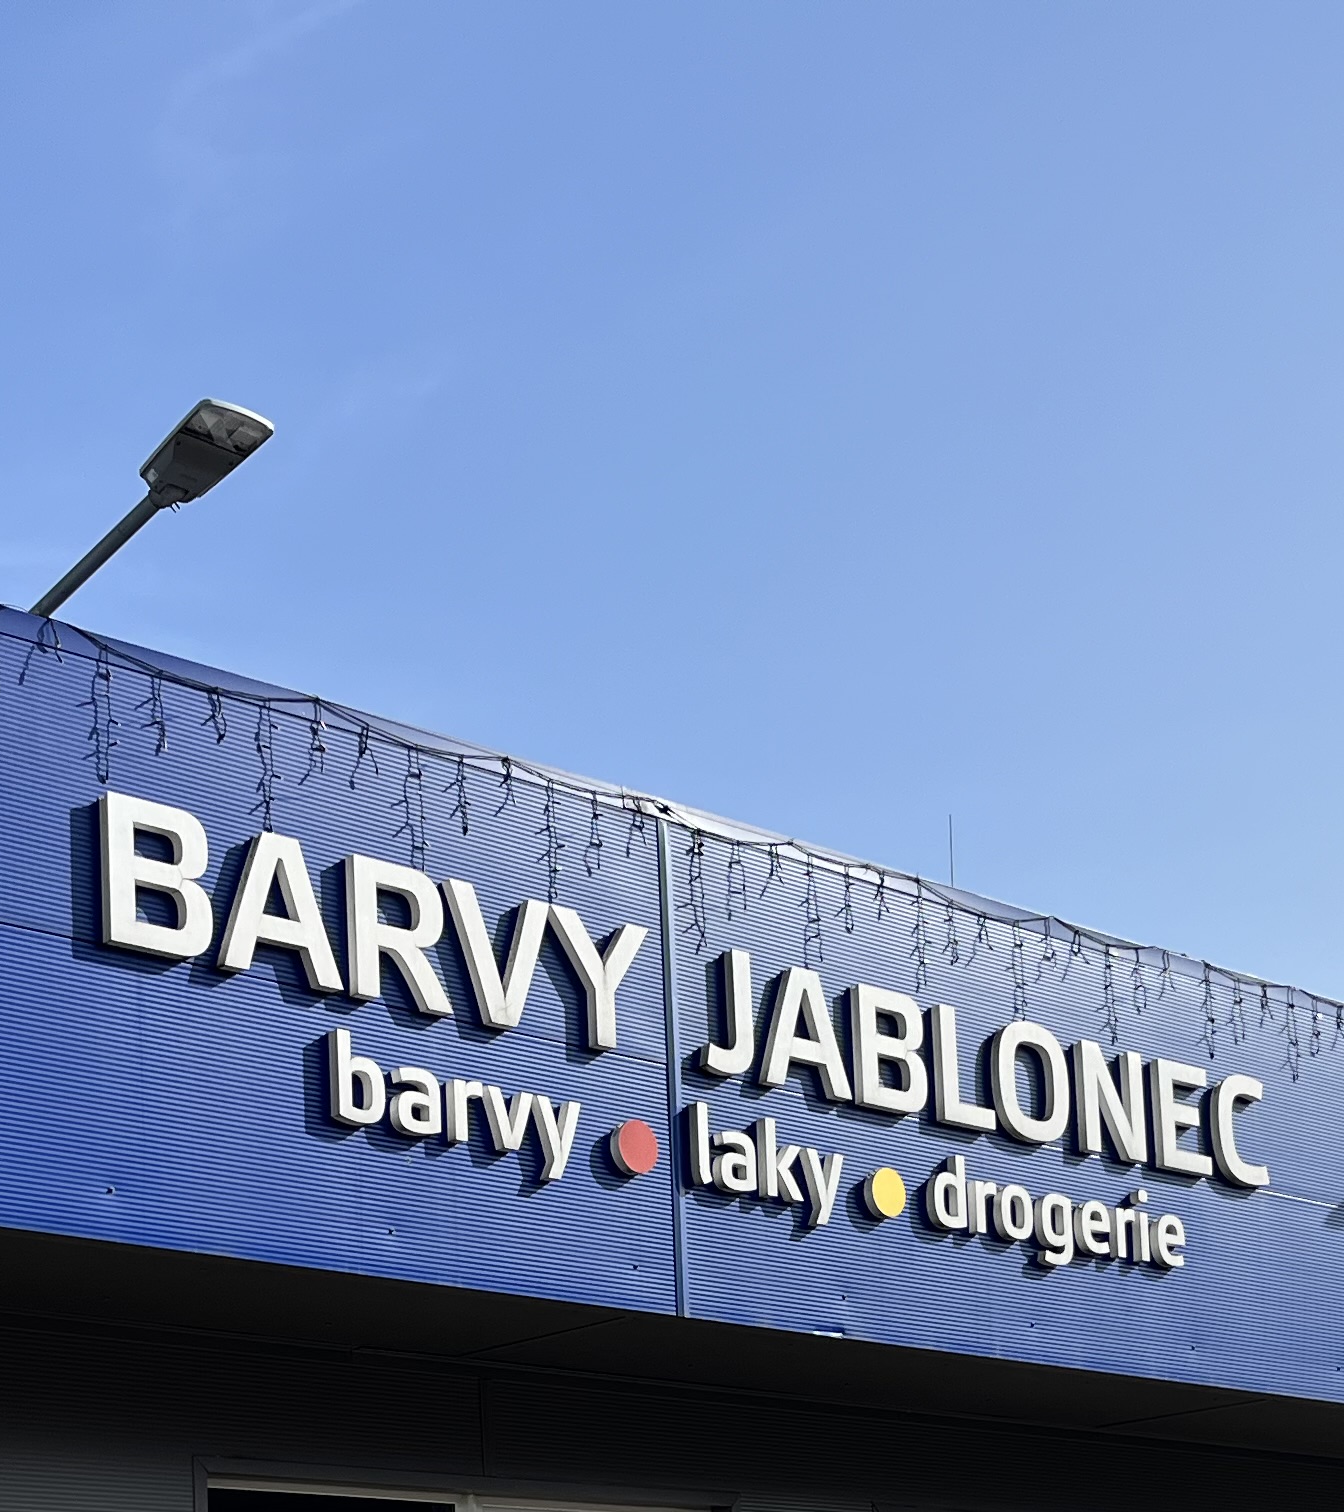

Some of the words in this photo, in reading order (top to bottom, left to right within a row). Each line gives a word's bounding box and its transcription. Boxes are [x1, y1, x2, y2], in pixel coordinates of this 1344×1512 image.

[99, 790, 648, 1053] BARVY
[698, 947, 1271, 1189] JABLONEC
[327, 1027, 581, 1183] barvy
[689, 1101, 845, 1227] laky
[925, 1155, 1186, 1269] drogerie
